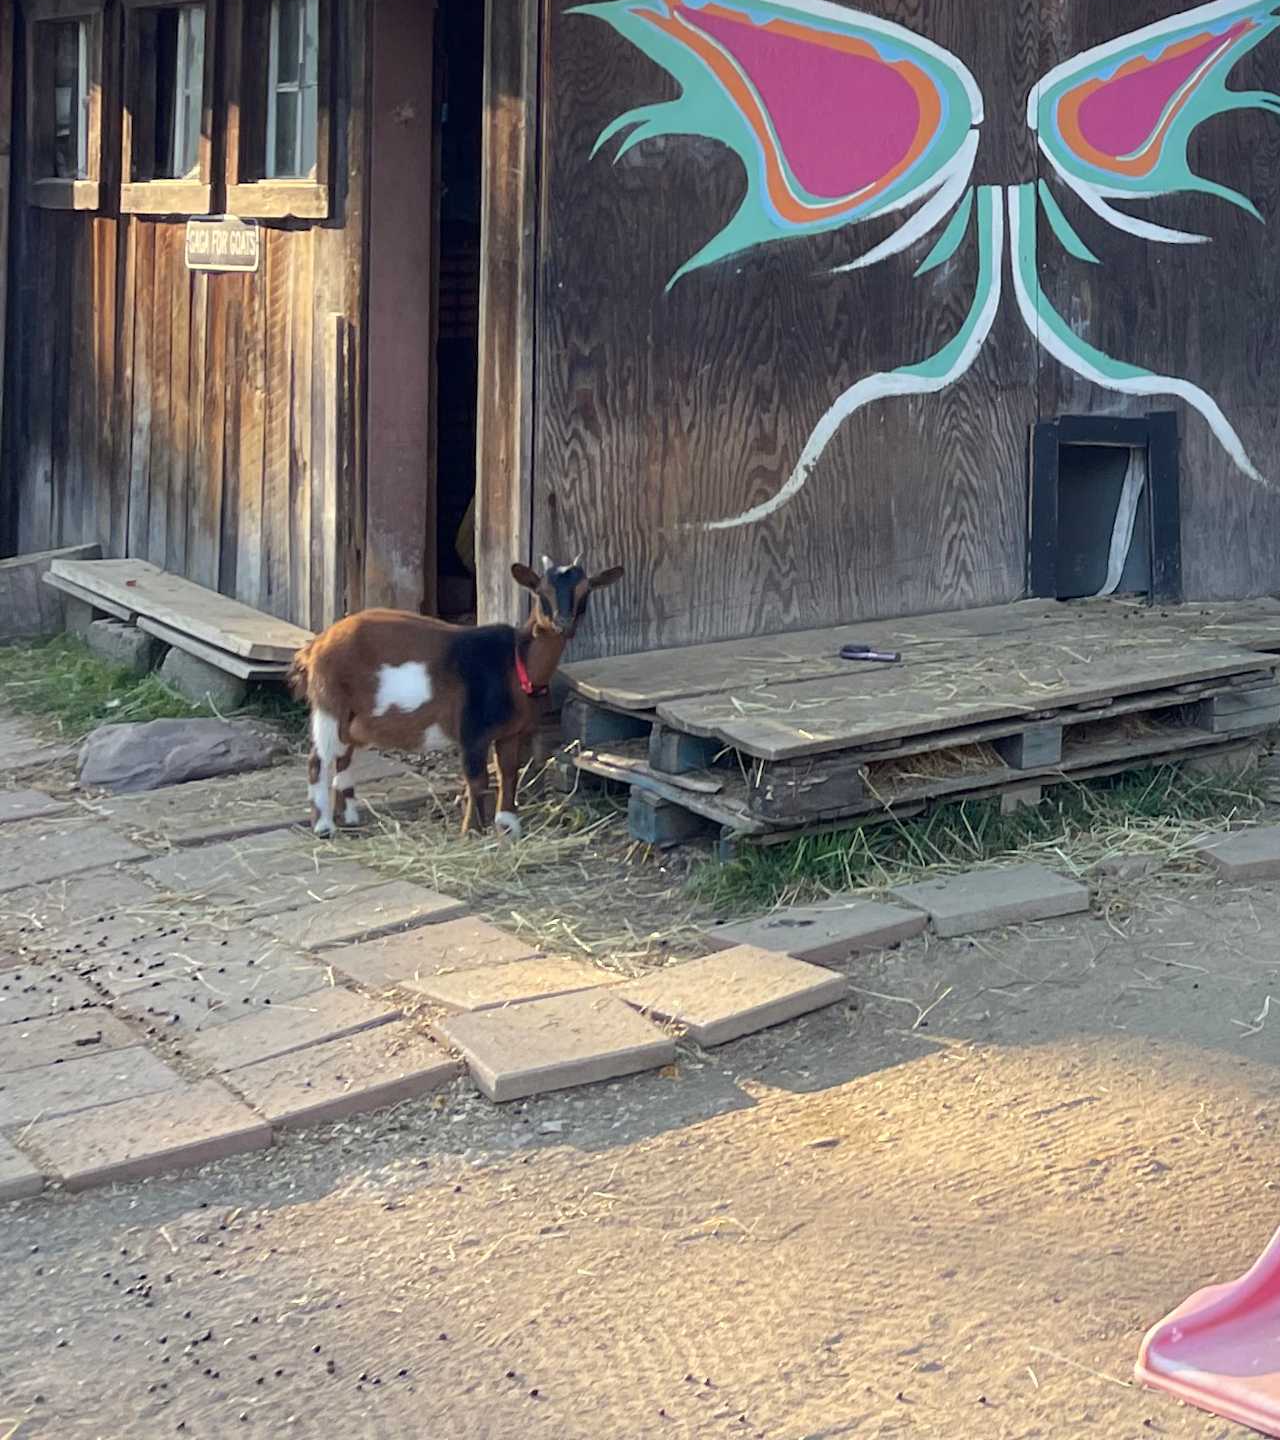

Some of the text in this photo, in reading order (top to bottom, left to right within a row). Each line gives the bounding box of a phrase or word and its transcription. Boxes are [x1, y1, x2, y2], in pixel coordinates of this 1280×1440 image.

[189, 229, 256, 256] GAGA FOR GOATS
